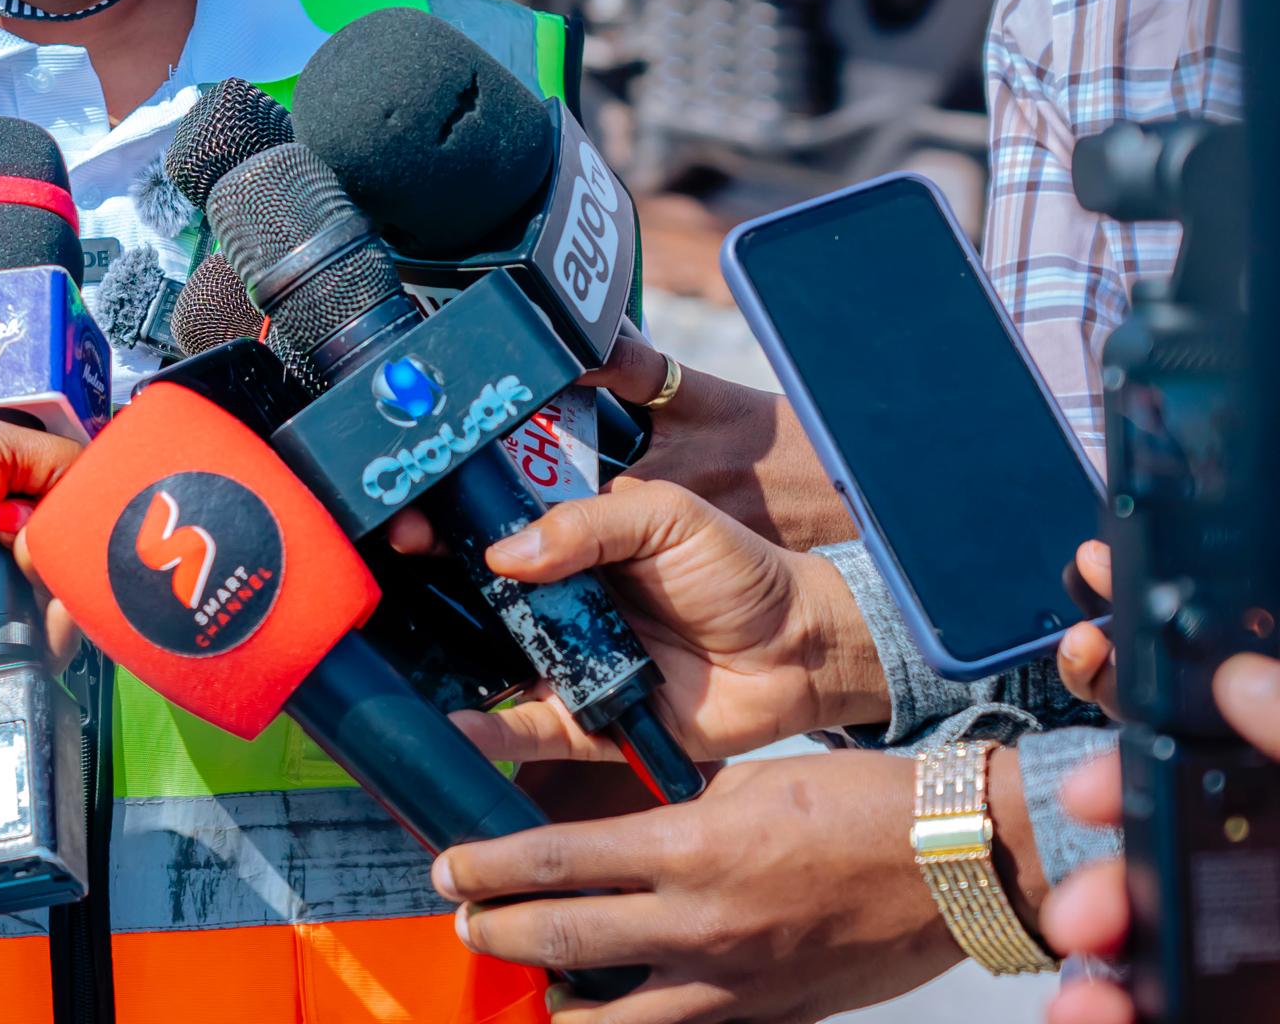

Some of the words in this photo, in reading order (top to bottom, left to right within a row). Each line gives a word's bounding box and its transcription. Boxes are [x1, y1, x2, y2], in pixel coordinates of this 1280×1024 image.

[563, 192, 609, 302] ayo
[194, 566, 248, 625] SMART
[195, 567, 272, 647] CHANNEL
